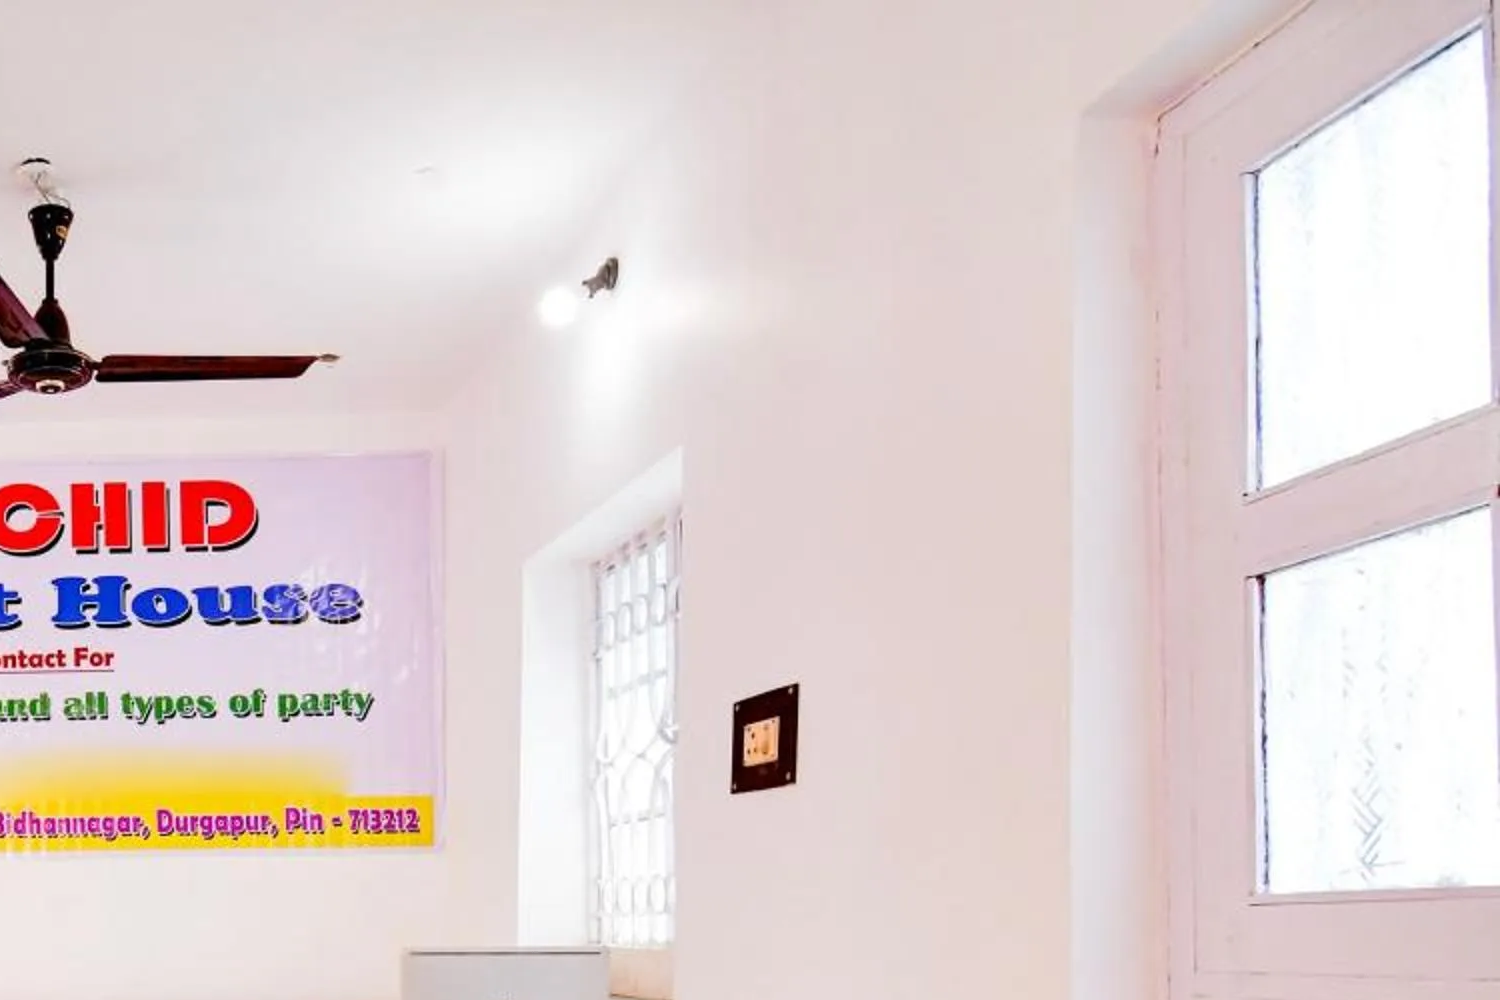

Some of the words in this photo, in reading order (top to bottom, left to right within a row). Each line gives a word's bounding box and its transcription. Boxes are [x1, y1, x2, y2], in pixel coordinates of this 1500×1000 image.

[51, 575, 363, 630] House
[73, 647, 115, 668] For
[63, 691, 109, 720] all
[121, 690, 217, 725] types
[228, 688, 267, 718] of
[277, 688, 374, 722] party
[156, 808, 279, 841] Durgapur,
[285, 807, 325, 835] Pin
[348, 809, 421, 835] 713212
